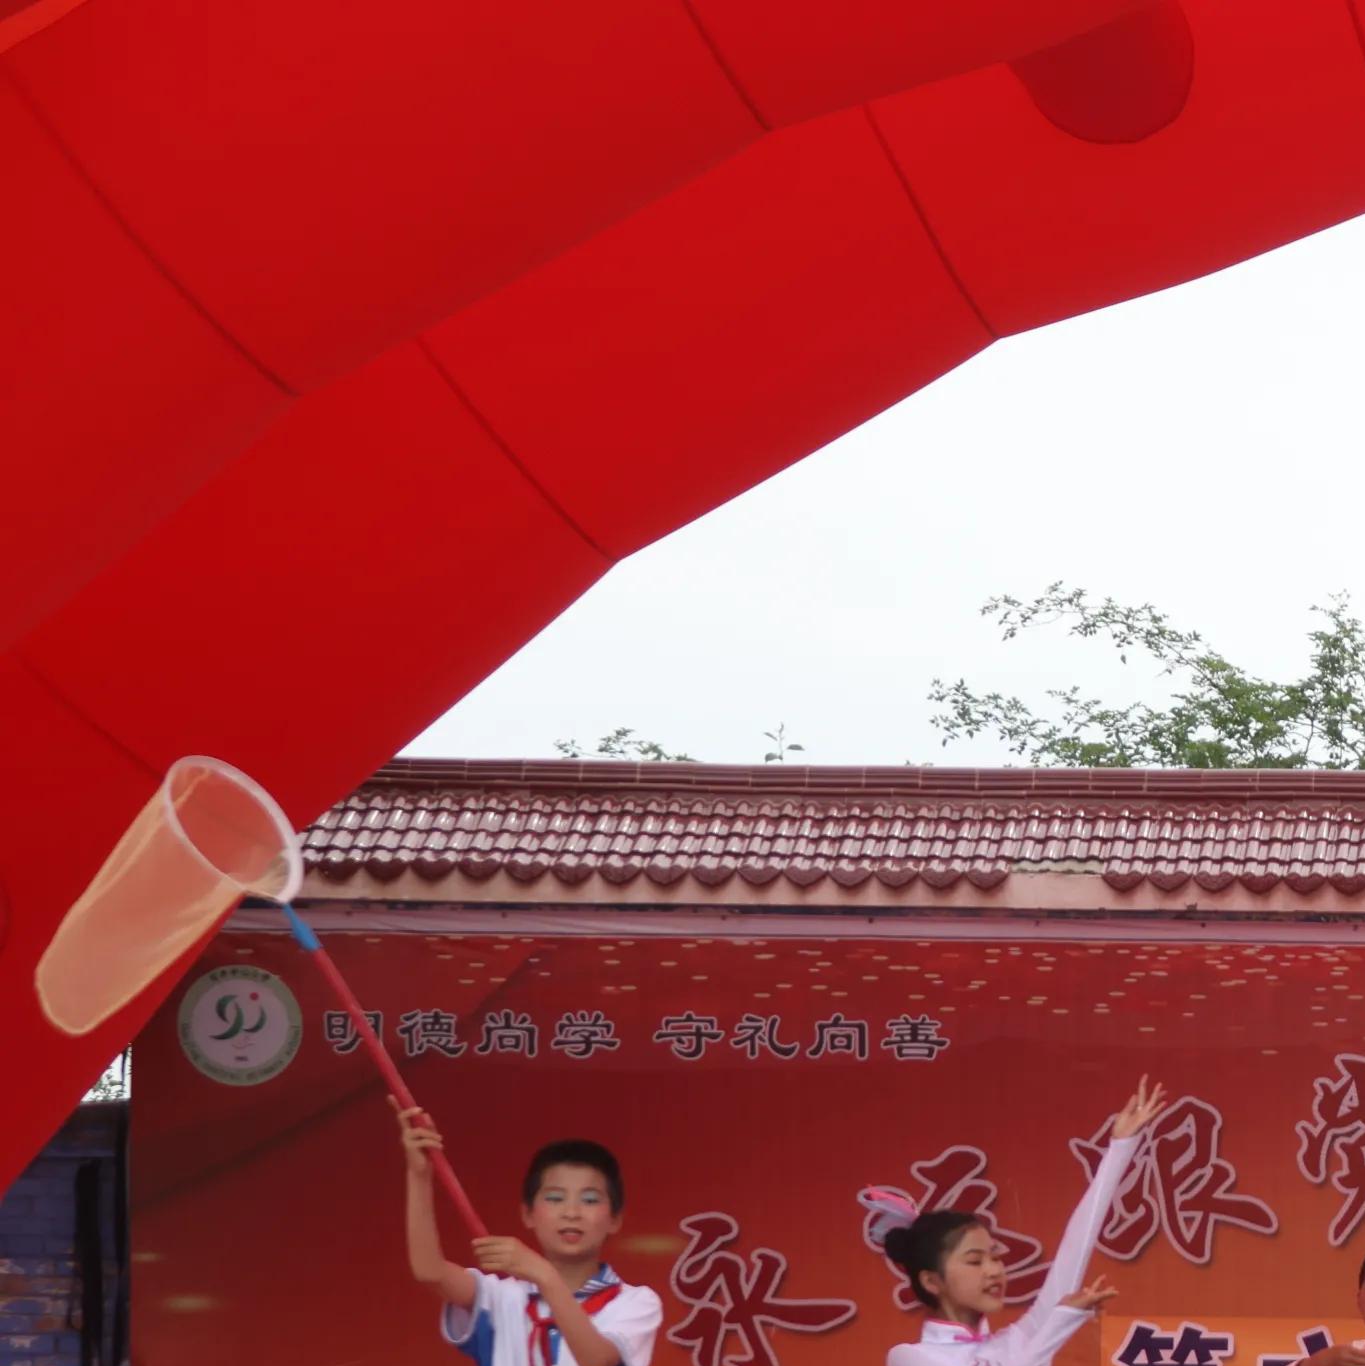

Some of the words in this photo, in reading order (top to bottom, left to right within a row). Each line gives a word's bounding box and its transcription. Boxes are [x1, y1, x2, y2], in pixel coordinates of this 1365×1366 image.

[325, 1009, 620, 1060] 明德尚学
[654, 1011, 950, 1061] 守礼向善
